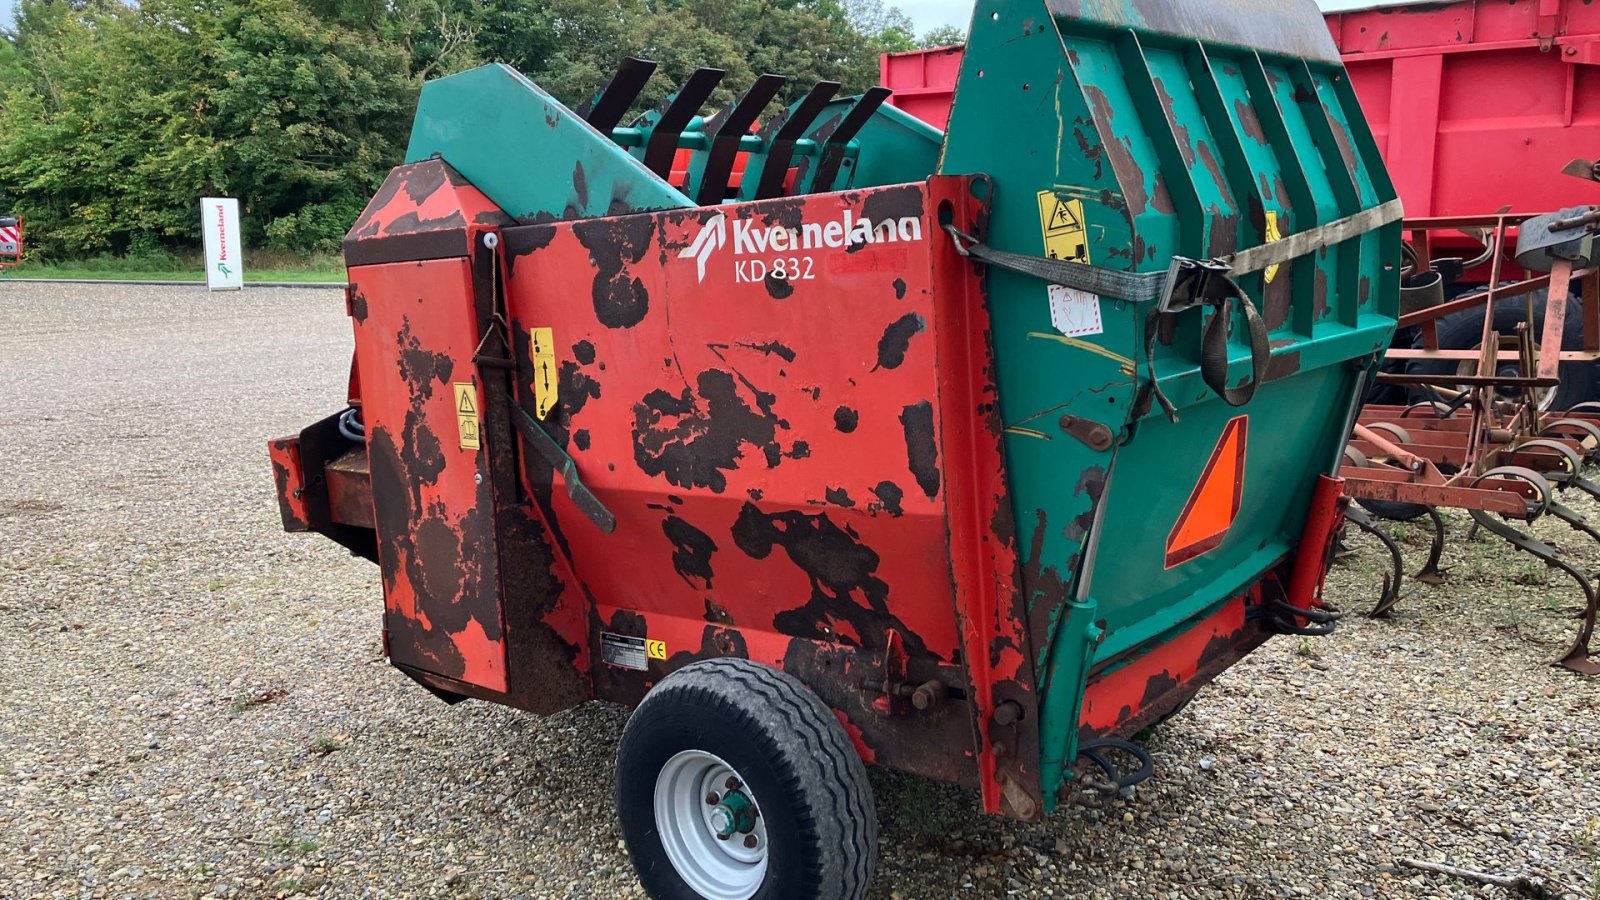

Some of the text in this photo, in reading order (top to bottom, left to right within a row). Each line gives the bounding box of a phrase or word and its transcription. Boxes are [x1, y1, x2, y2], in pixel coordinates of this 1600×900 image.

[216, 204, 227, 261] Kverneland
[732, 210, 922, 254] Kverneland
[735, 256, 815, 283] KD 832
[649, 641, 664, 658] CE
